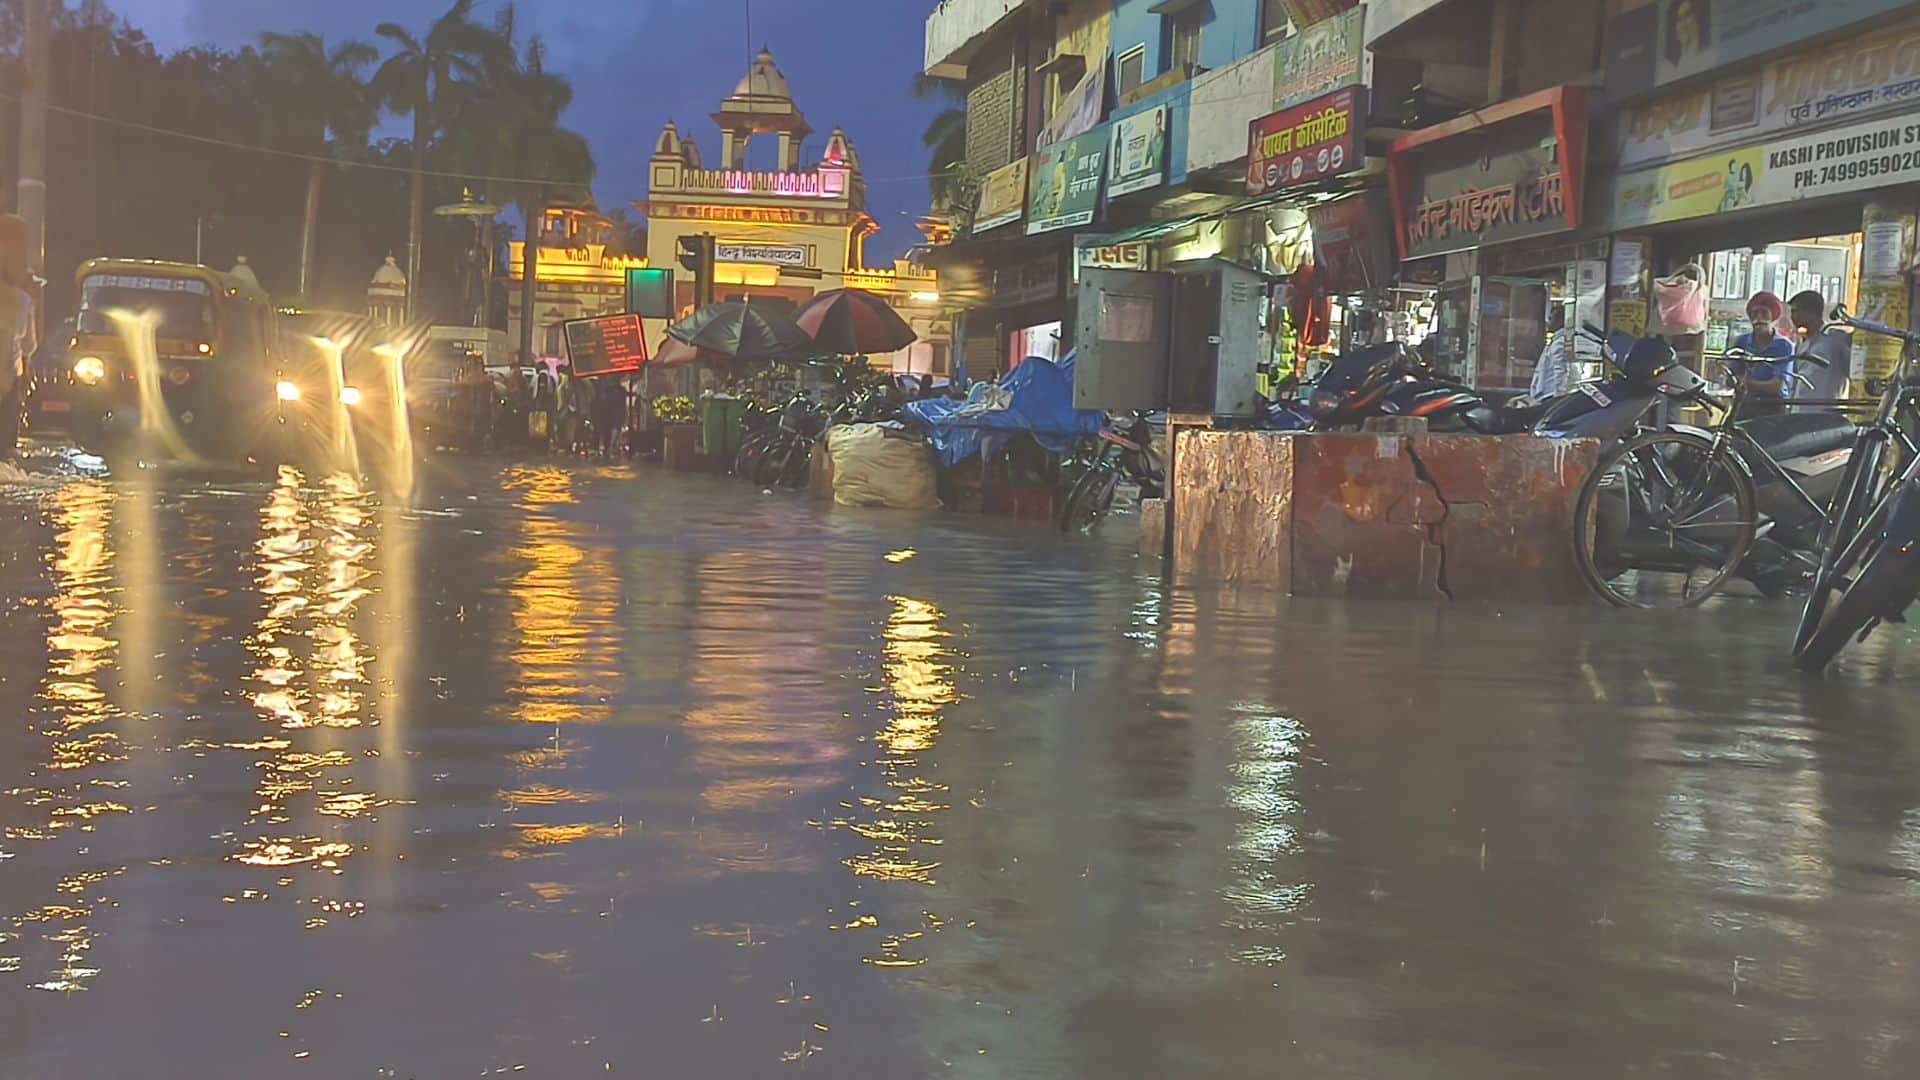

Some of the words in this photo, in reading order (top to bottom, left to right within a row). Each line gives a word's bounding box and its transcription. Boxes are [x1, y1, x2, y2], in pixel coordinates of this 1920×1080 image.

[1263, 128, 1294, 160] पायल
[1769, 145, 1813, 169] KASHI
[1816, 127, 1900, 161] PROVISION
[1794, 169, 1818, 189] PH:
